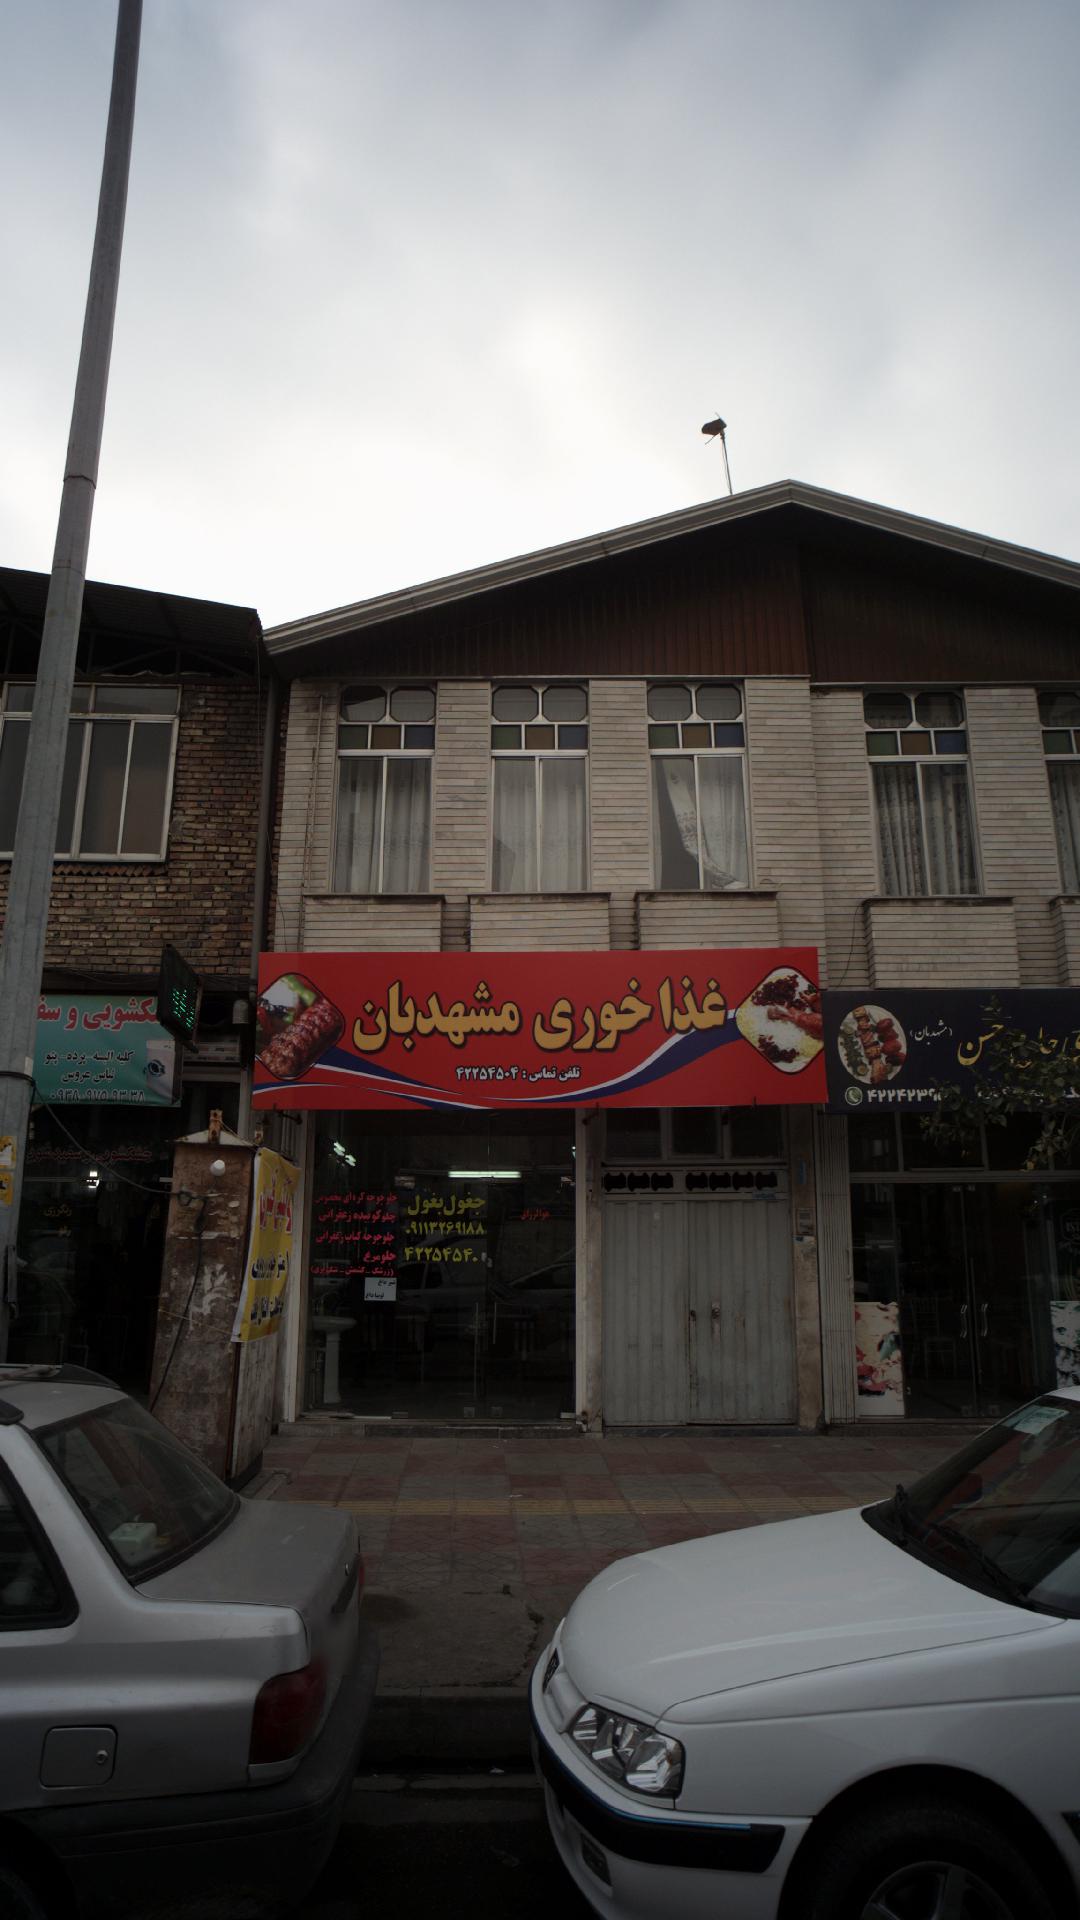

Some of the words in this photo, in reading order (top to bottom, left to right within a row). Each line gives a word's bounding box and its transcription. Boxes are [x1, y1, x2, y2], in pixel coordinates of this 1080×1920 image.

[38, 995, 61, 1021] سف
[64, 1006, 77, 1030] و
[352, 980, 521, 1053] مشهدبان
[533, 977, 653, 1051] خوری
[658, 976, 727, 1034] غذا
[456, 1065, 519, 1080] ۴۲۲۵۴۵۰۴
[558, 1065, 581, 1081] تلفن
